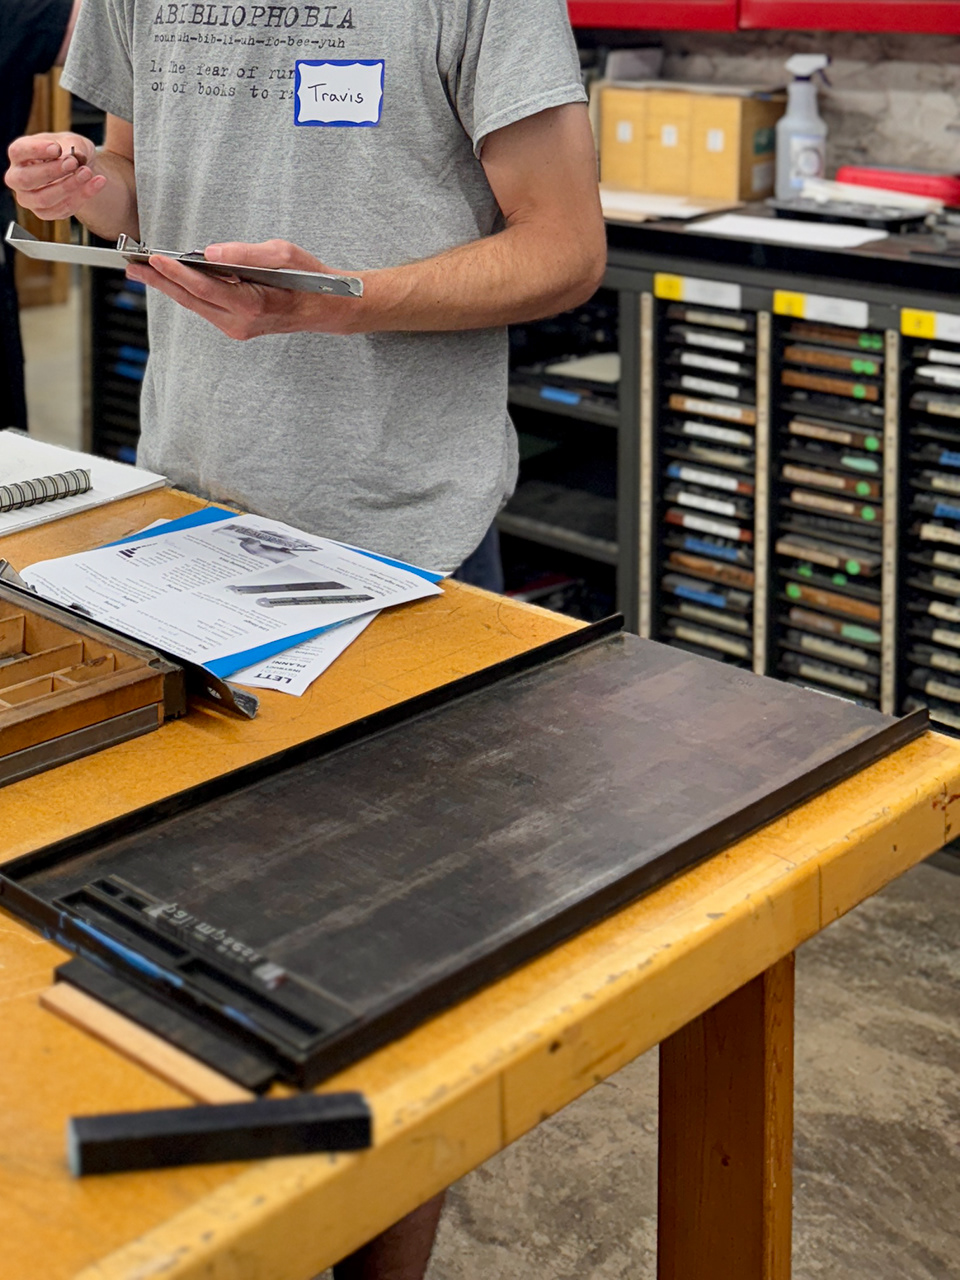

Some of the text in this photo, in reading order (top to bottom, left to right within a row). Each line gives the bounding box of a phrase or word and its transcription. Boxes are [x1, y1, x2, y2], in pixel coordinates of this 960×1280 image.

[153, 3, 356, 30] ABIBLIOPHOBIA
[196, 62, 230, 77] fear
[236, 65, 259, 79] of
[172, 81, 189, 94] of
[197, 81, 236, 97] books
[250, 84, 269, 100] to
[307, 83, 364, 105] Travis
